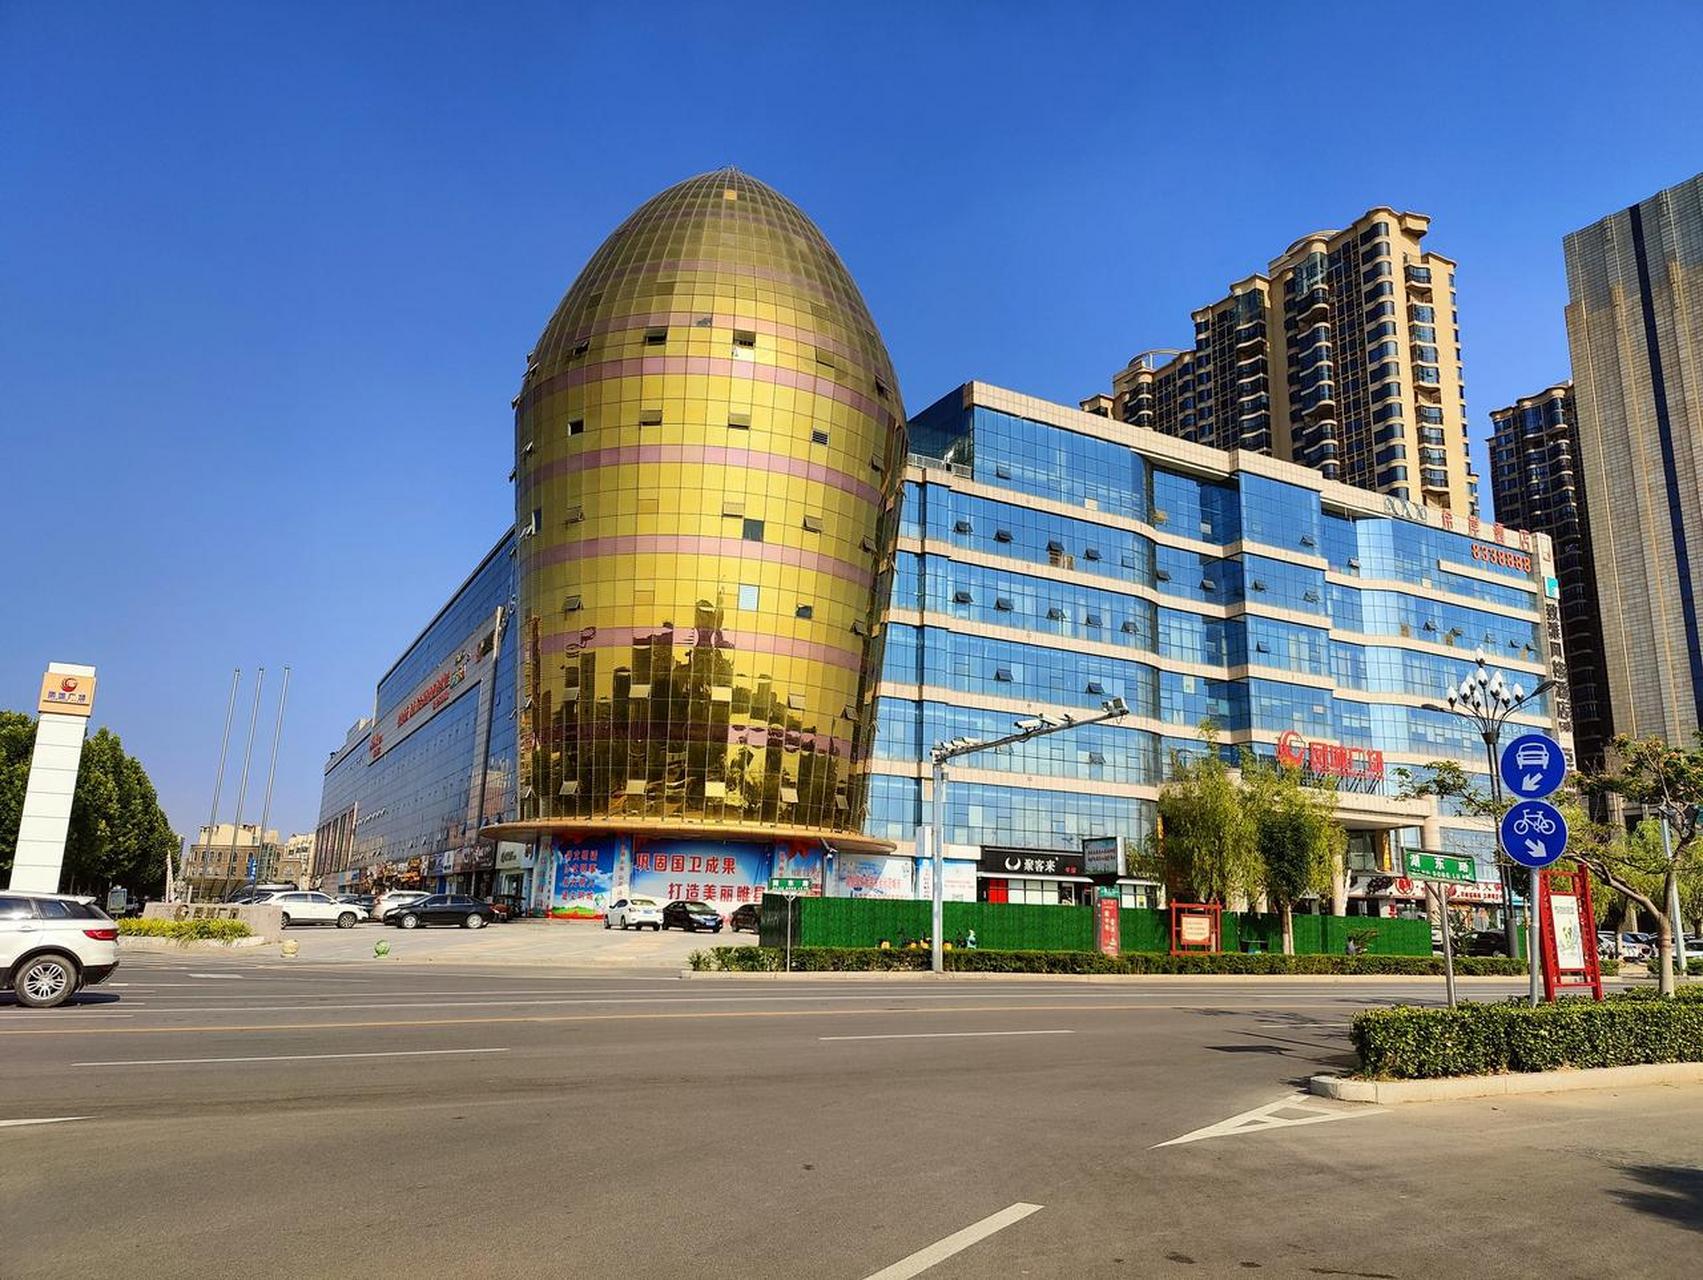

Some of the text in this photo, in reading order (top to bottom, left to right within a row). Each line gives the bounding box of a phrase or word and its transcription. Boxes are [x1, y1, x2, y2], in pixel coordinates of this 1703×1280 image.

[1471, 542, 1532, 574] 8338888
[635, 852, 737, 875] 巩固国卫成果
[1023, 858, 1056, 873] 聚客来
